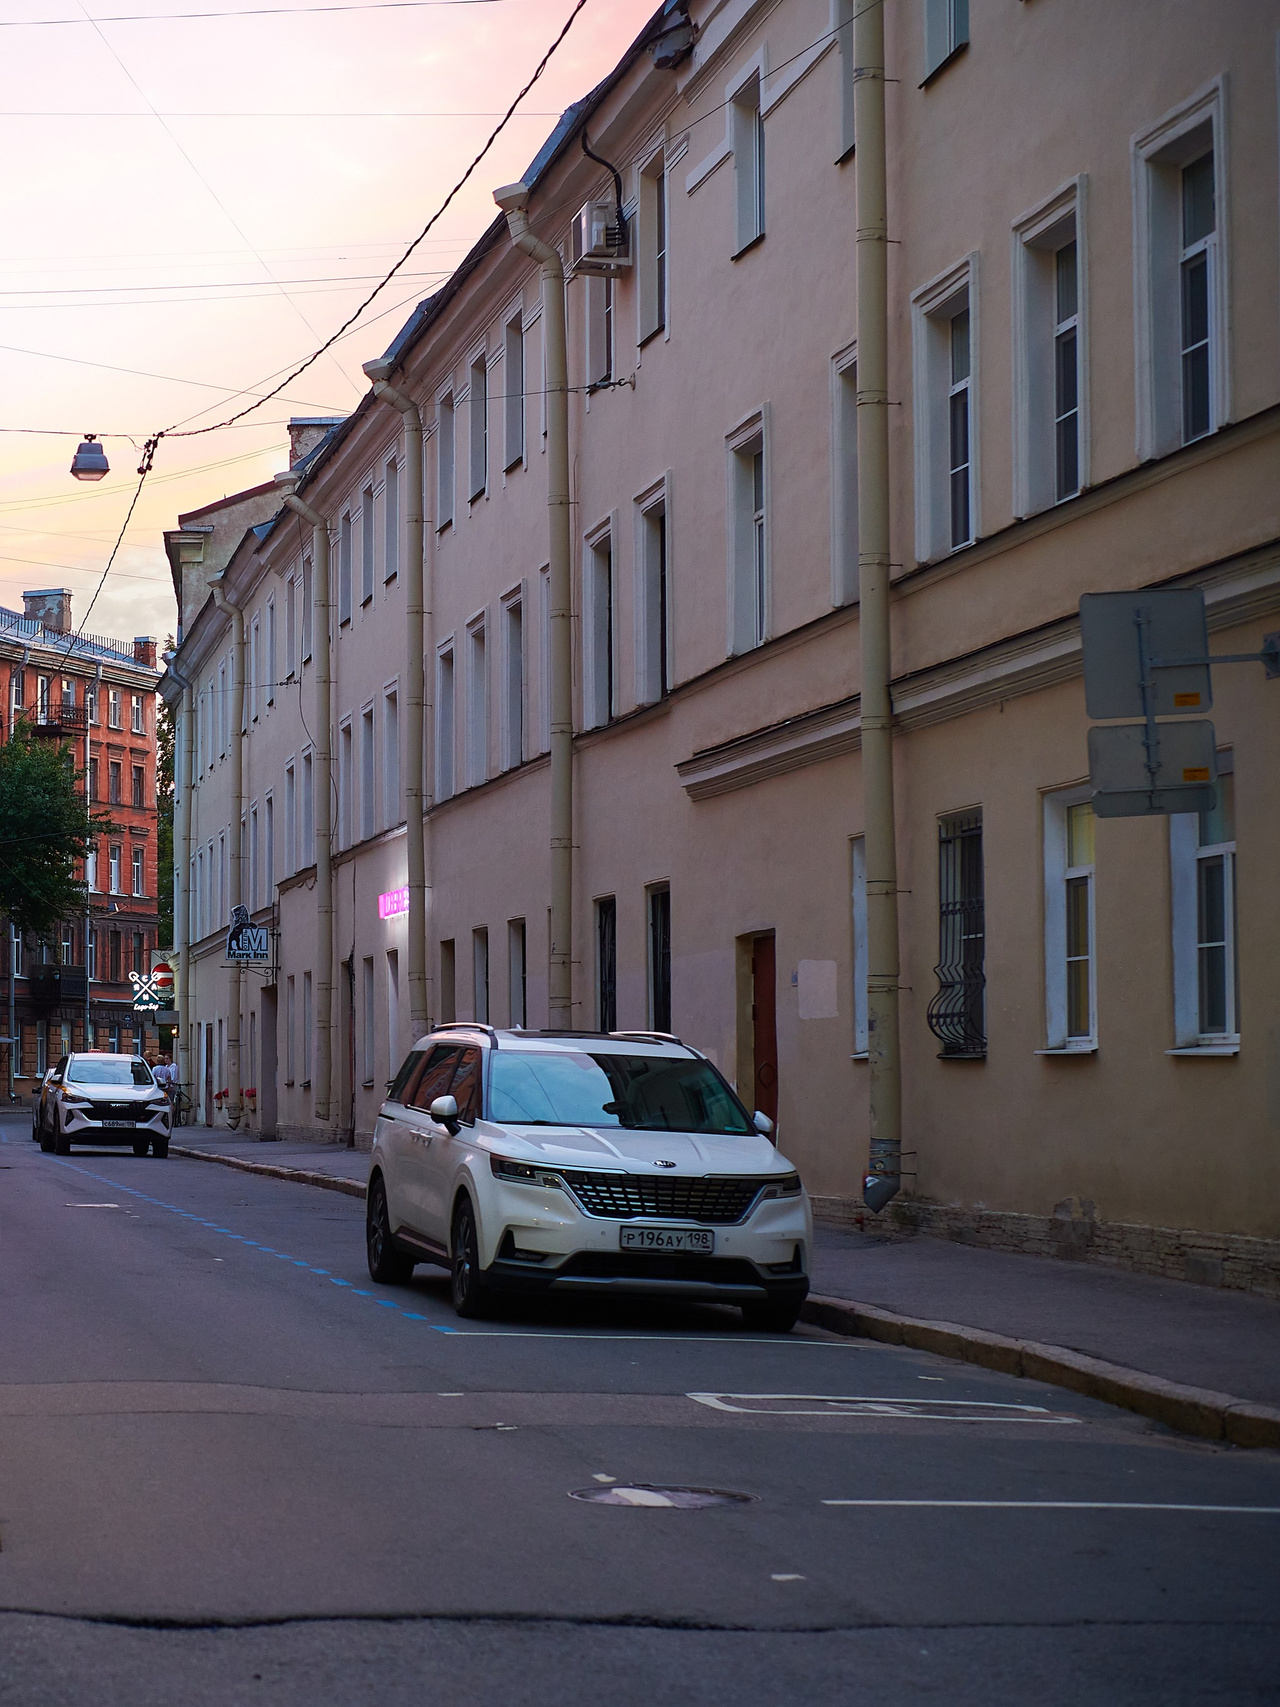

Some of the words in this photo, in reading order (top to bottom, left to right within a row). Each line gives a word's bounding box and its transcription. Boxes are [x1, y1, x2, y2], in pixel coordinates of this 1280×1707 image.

[227, 951, 251, 959] Mark
[254, 951, 268, 959] Inn
[626, 1231, 683, 1247] Р196АУ
[687, 1232, 708, 1244] 198
